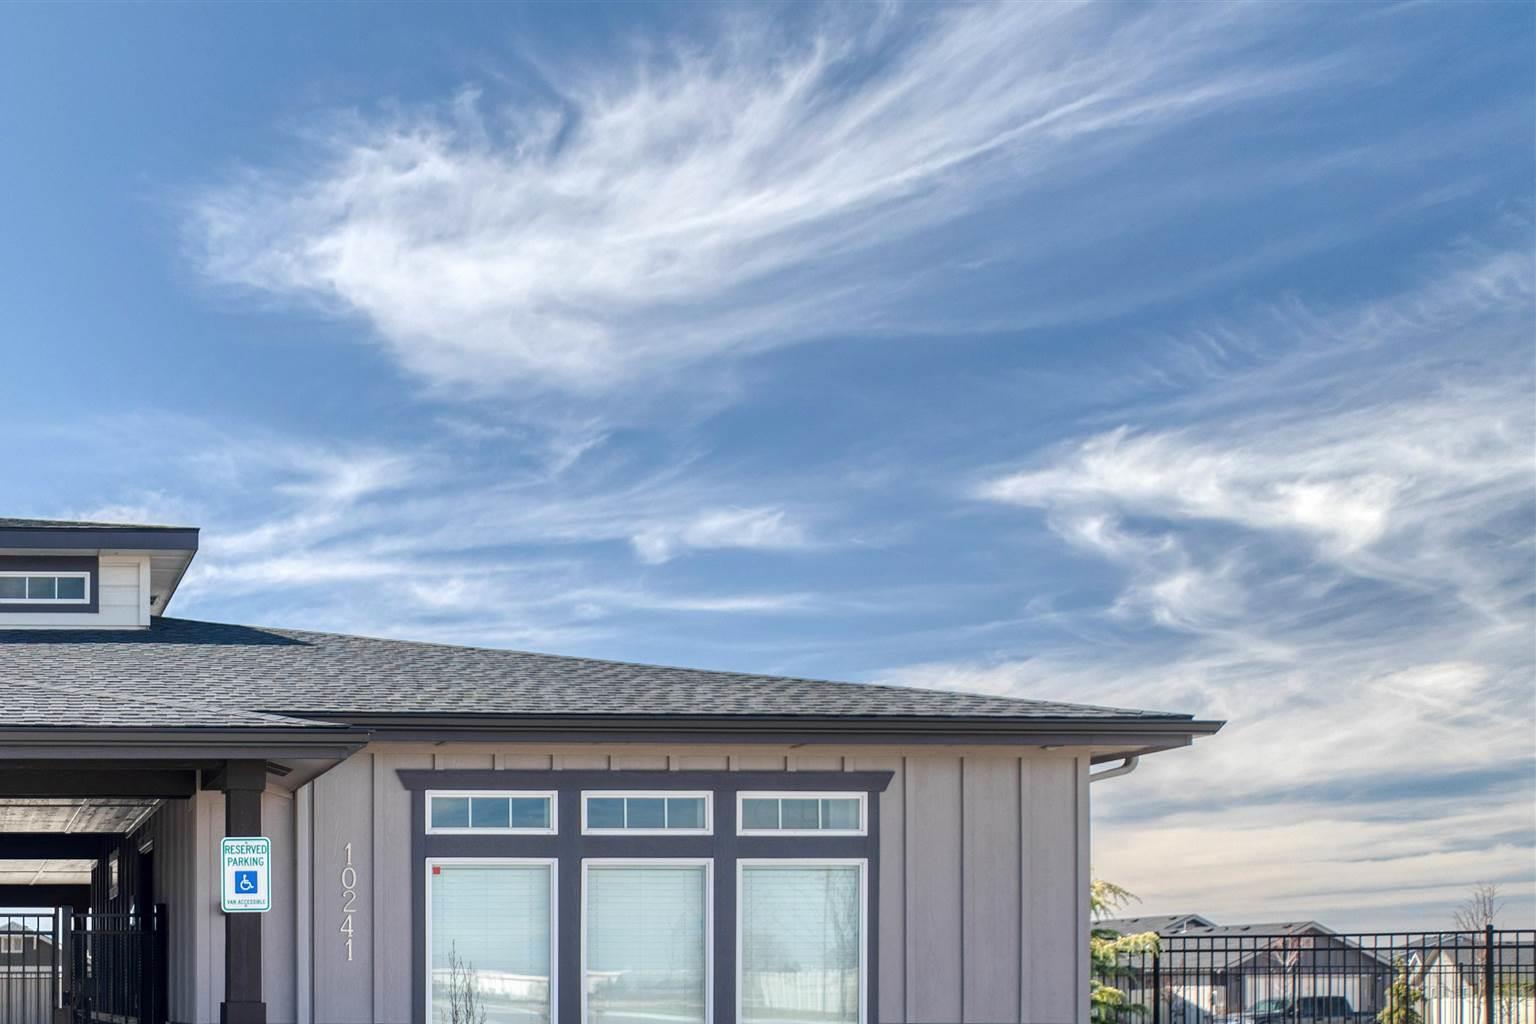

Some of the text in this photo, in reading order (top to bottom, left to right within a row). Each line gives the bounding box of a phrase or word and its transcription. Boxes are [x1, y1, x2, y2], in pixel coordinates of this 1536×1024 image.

[224, 845, 267, 854] RESERVED
[227, 857, 264, 866] PARKING
[340, 842, 356, 961] 10241
